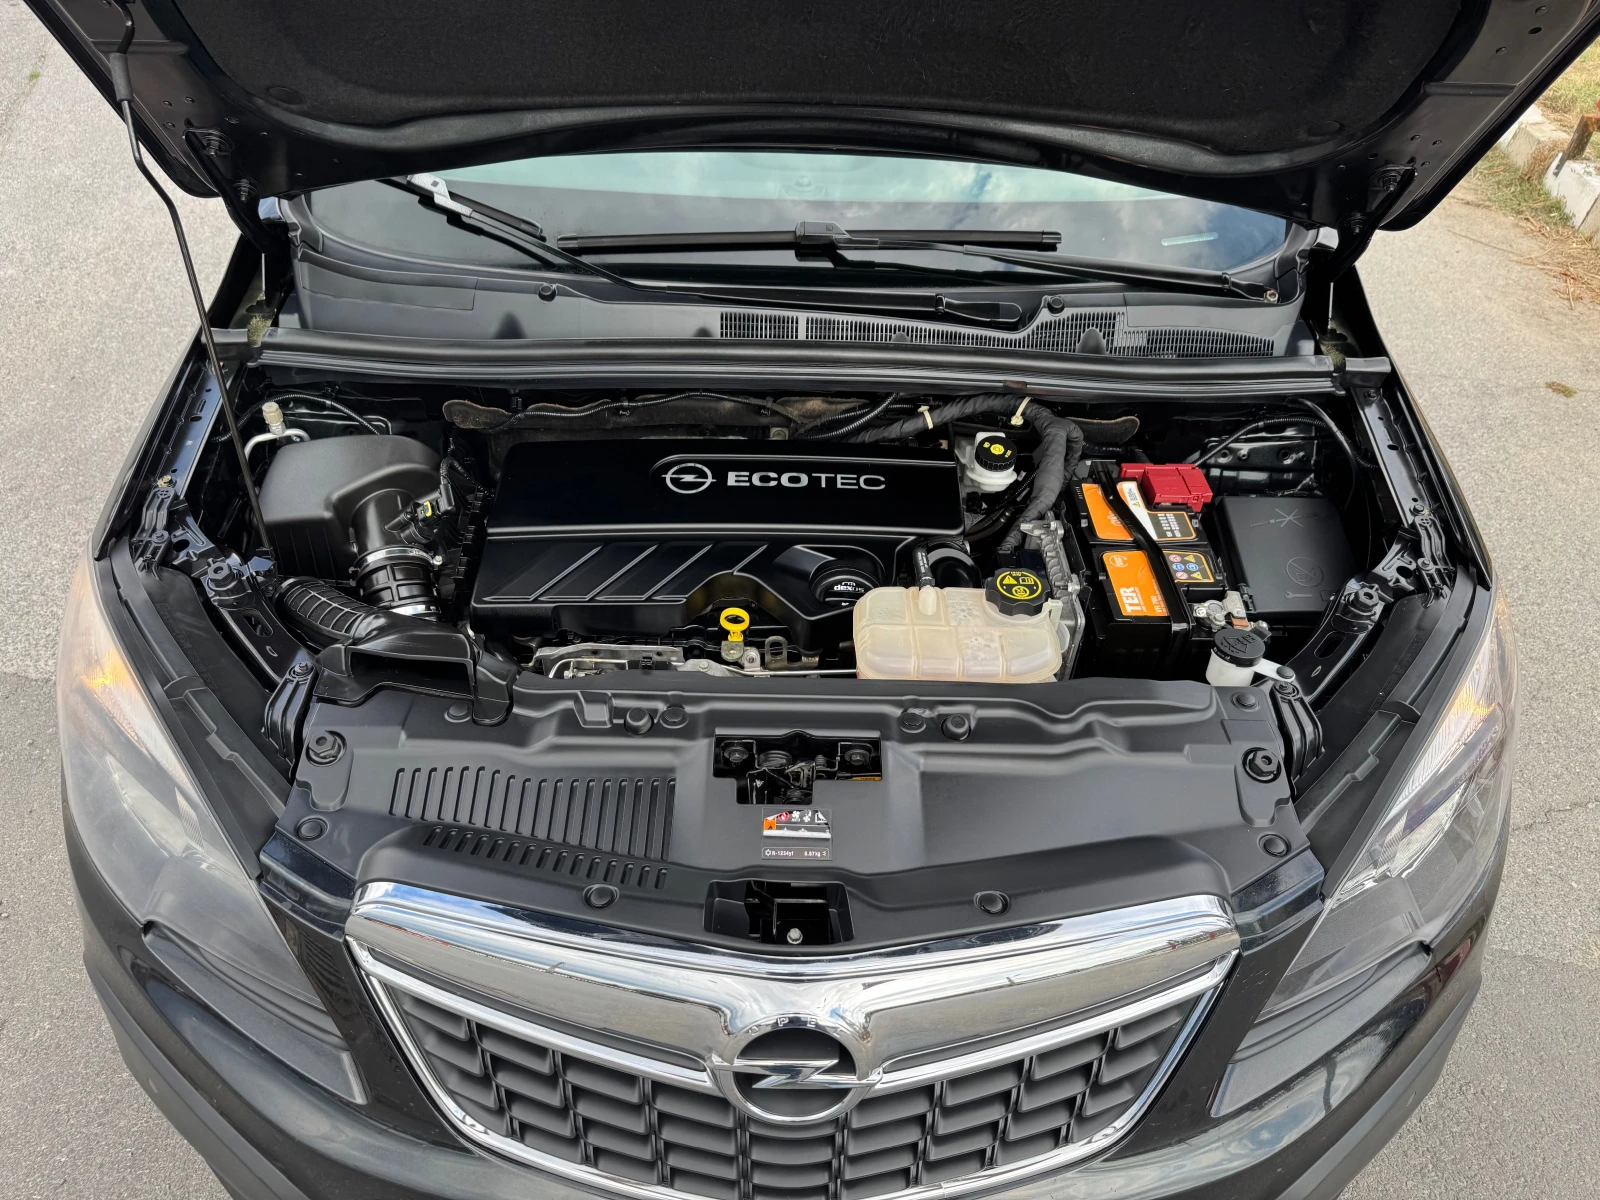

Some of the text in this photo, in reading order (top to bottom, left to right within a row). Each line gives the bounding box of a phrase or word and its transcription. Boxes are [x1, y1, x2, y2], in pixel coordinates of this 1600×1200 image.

[727, 472, 886, 490] ECOTEC
[834, 584, 864, 592] dexos
[748, 1017, 841, 1037] OPEL
